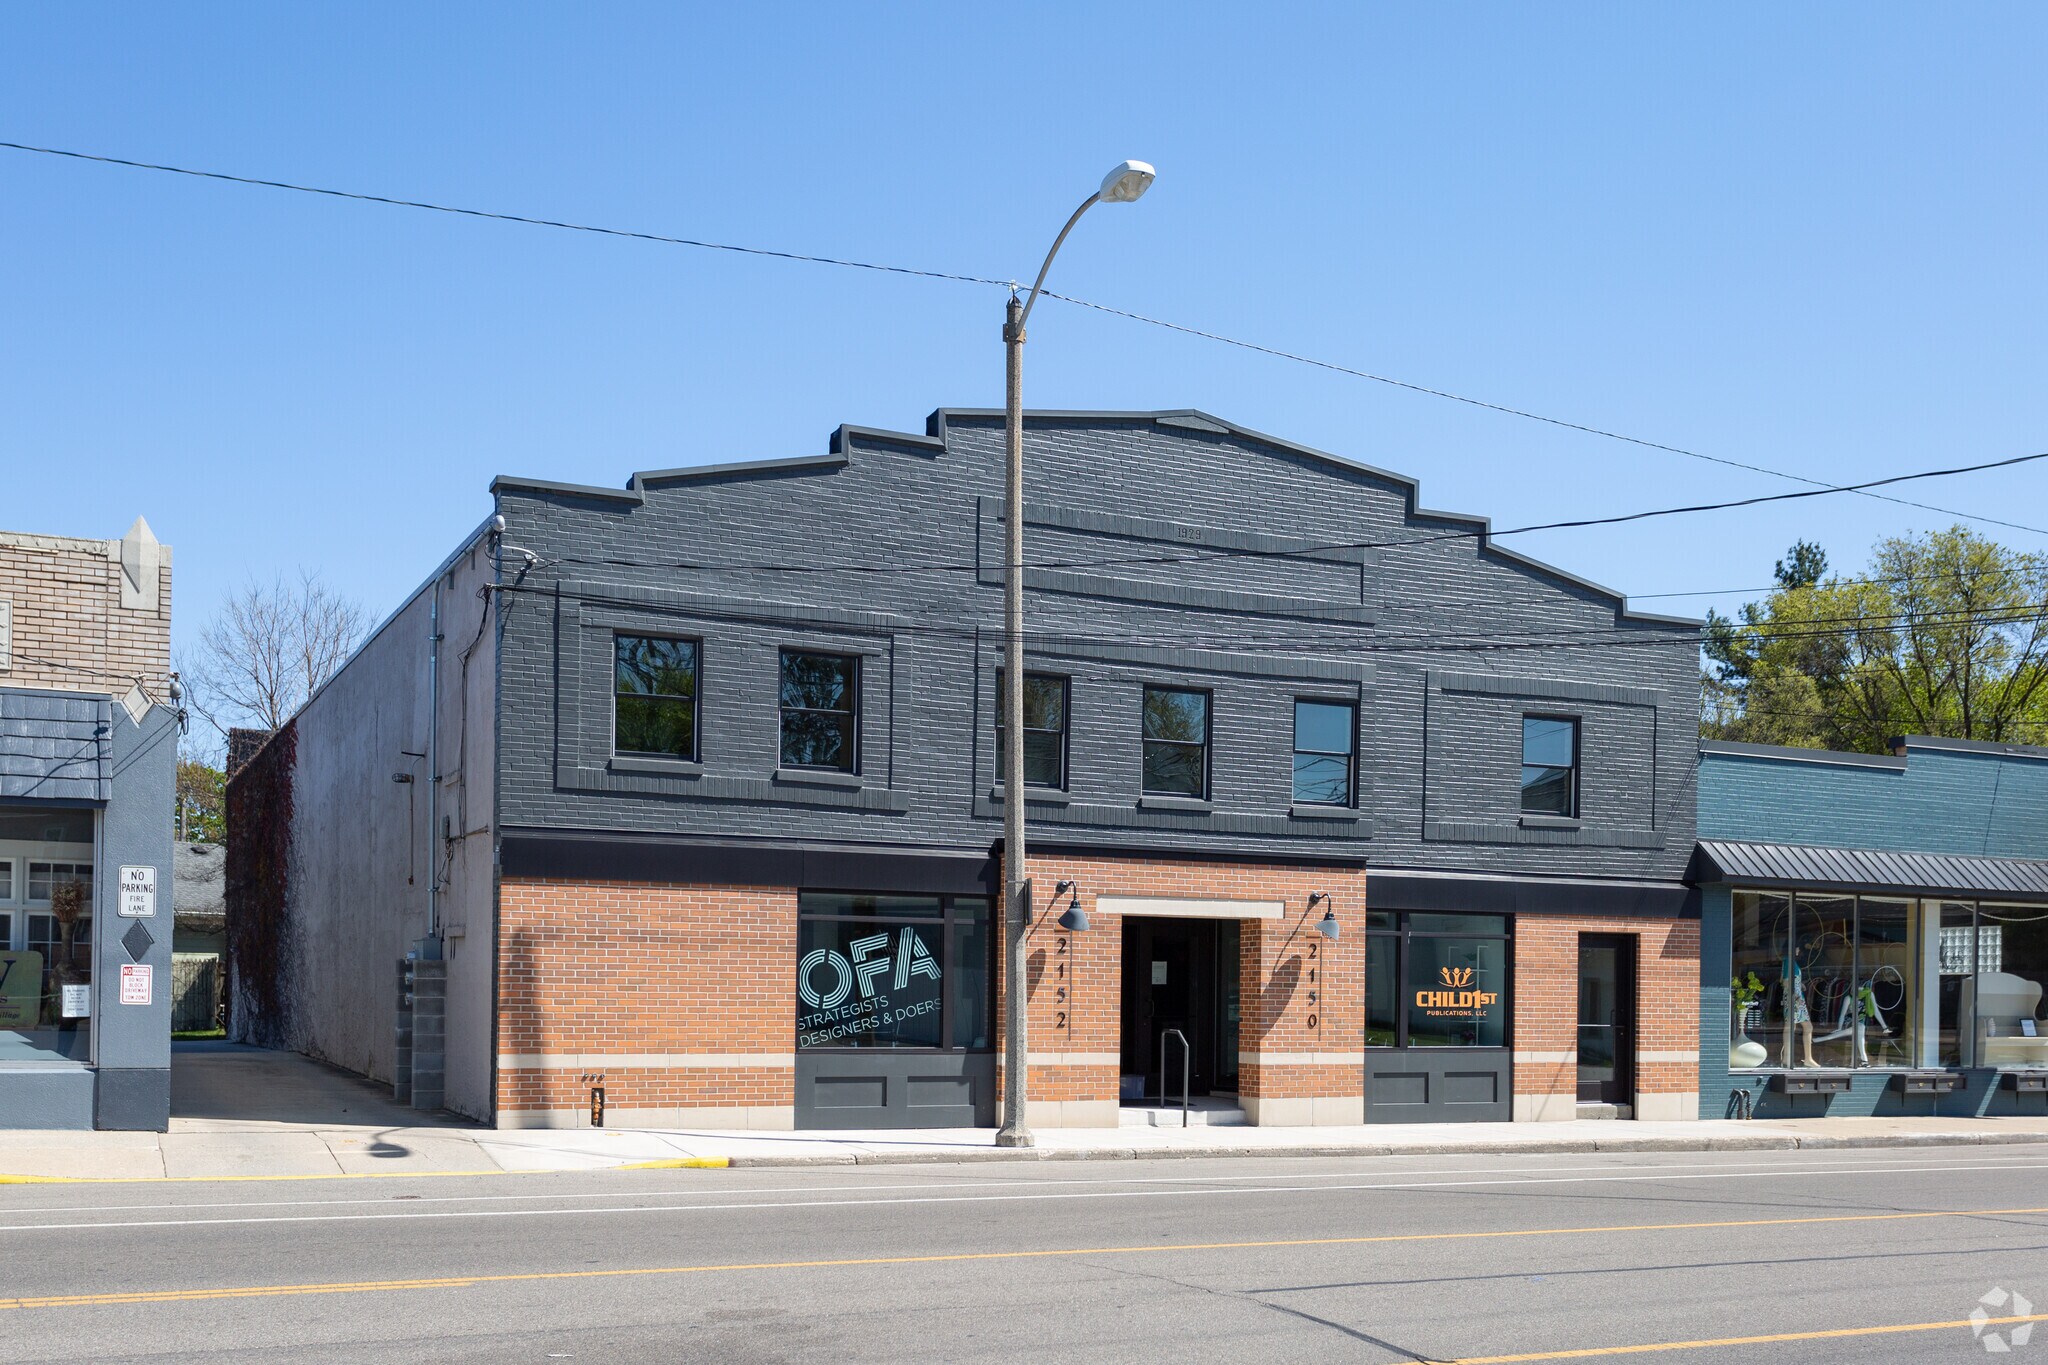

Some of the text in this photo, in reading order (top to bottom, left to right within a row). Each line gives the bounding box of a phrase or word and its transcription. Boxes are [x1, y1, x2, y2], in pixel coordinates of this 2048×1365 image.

[1177, 527, 1202, 540] 1929
[131, 871, 145, 881] NO
[121, 883, 154, 894] PARKING
[129, 895, 145, 903] FIRE
[128, 904, 146, 912] LANE
[123, 967, 132, 976] NO
[799, 926, 942, 1010] OFA
[1055, 937, 1067, 1029] 2152
[1307, 943, 1317, 1030] 2150
[799, 995, 889, 1031] STRATEGISTS
[800, 997, 942, 1048] DESIGNERS & DOERS
